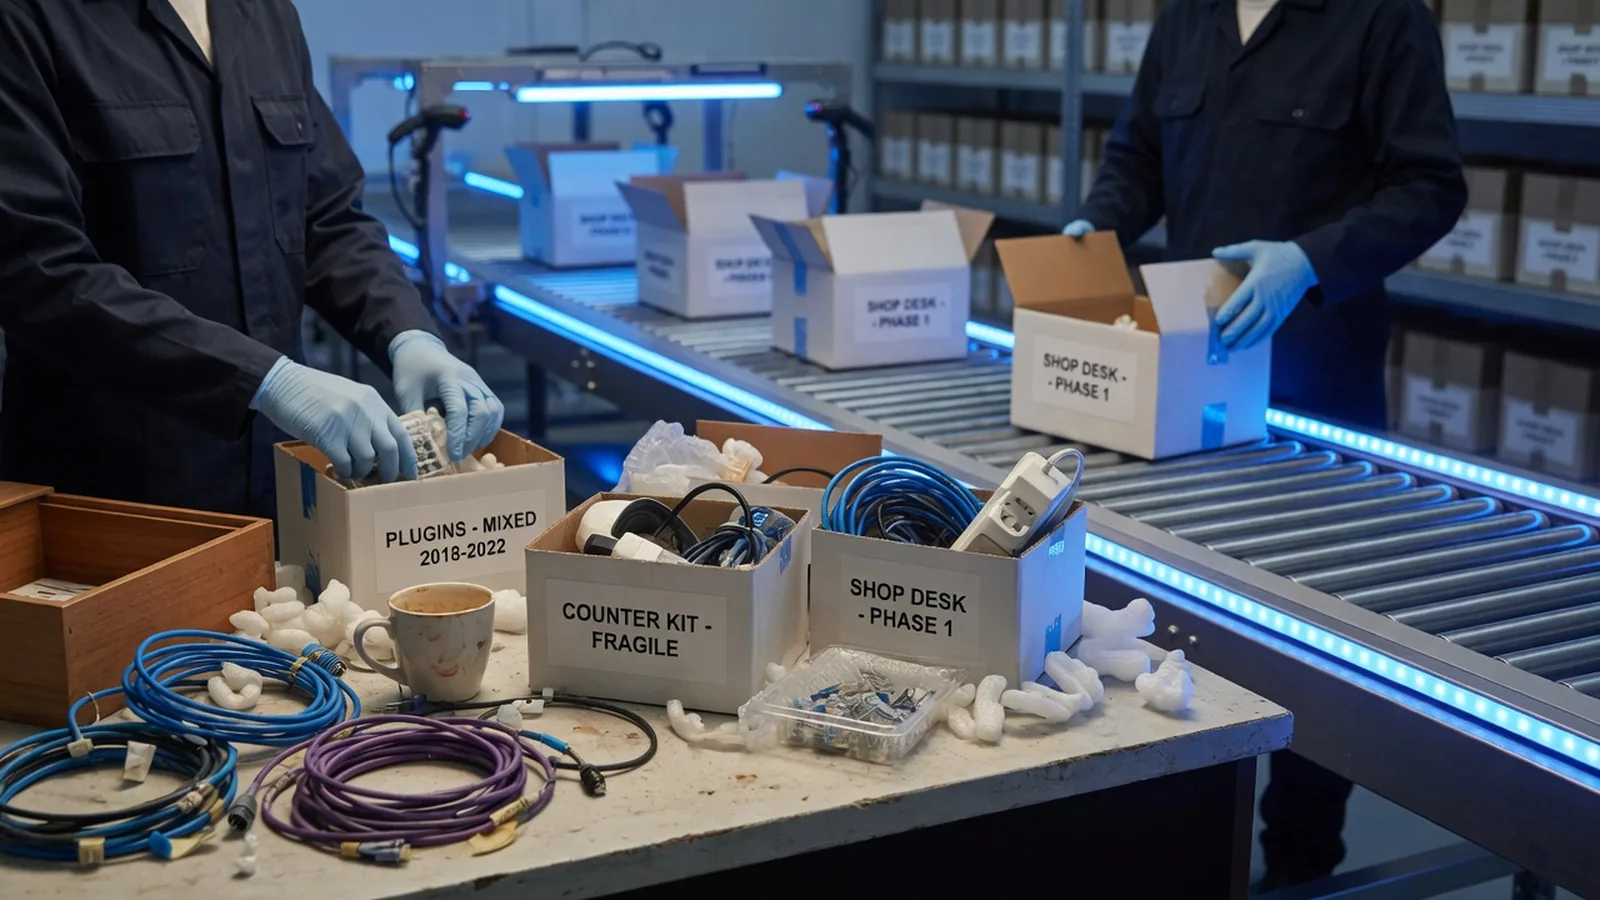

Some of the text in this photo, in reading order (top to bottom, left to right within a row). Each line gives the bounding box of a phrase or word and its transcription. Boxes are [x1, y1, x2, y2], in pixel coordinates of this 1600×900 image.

[867, 299, 900, 313] SHOP
[904, 297, 937, 310] DESK
[879, 314, 920, 329] PHASE
[924, 313, 930, 326] 1
[1043, 352, 1079, 372] SHOP
[1082, 360, 1118, 382] DESK
[1055, 376, 1099, 400] PHASE
[1103, 387, 1109, 402] 1
[385, 521, 466, 548] PLUGINS
[483, 511, 537, 533] MIXED
[420, 538, 506, 567] 2018-2022
[850, 578, 967, 613] SHOP DESK
[562, 602, 661, 629] COUNTER
[667, 612, 699, 633] KIT
[870, 607, 937, 634] PHASE
[944, 619, 952, 637] 1
[591, 630, 679, 657] FRAGILE
